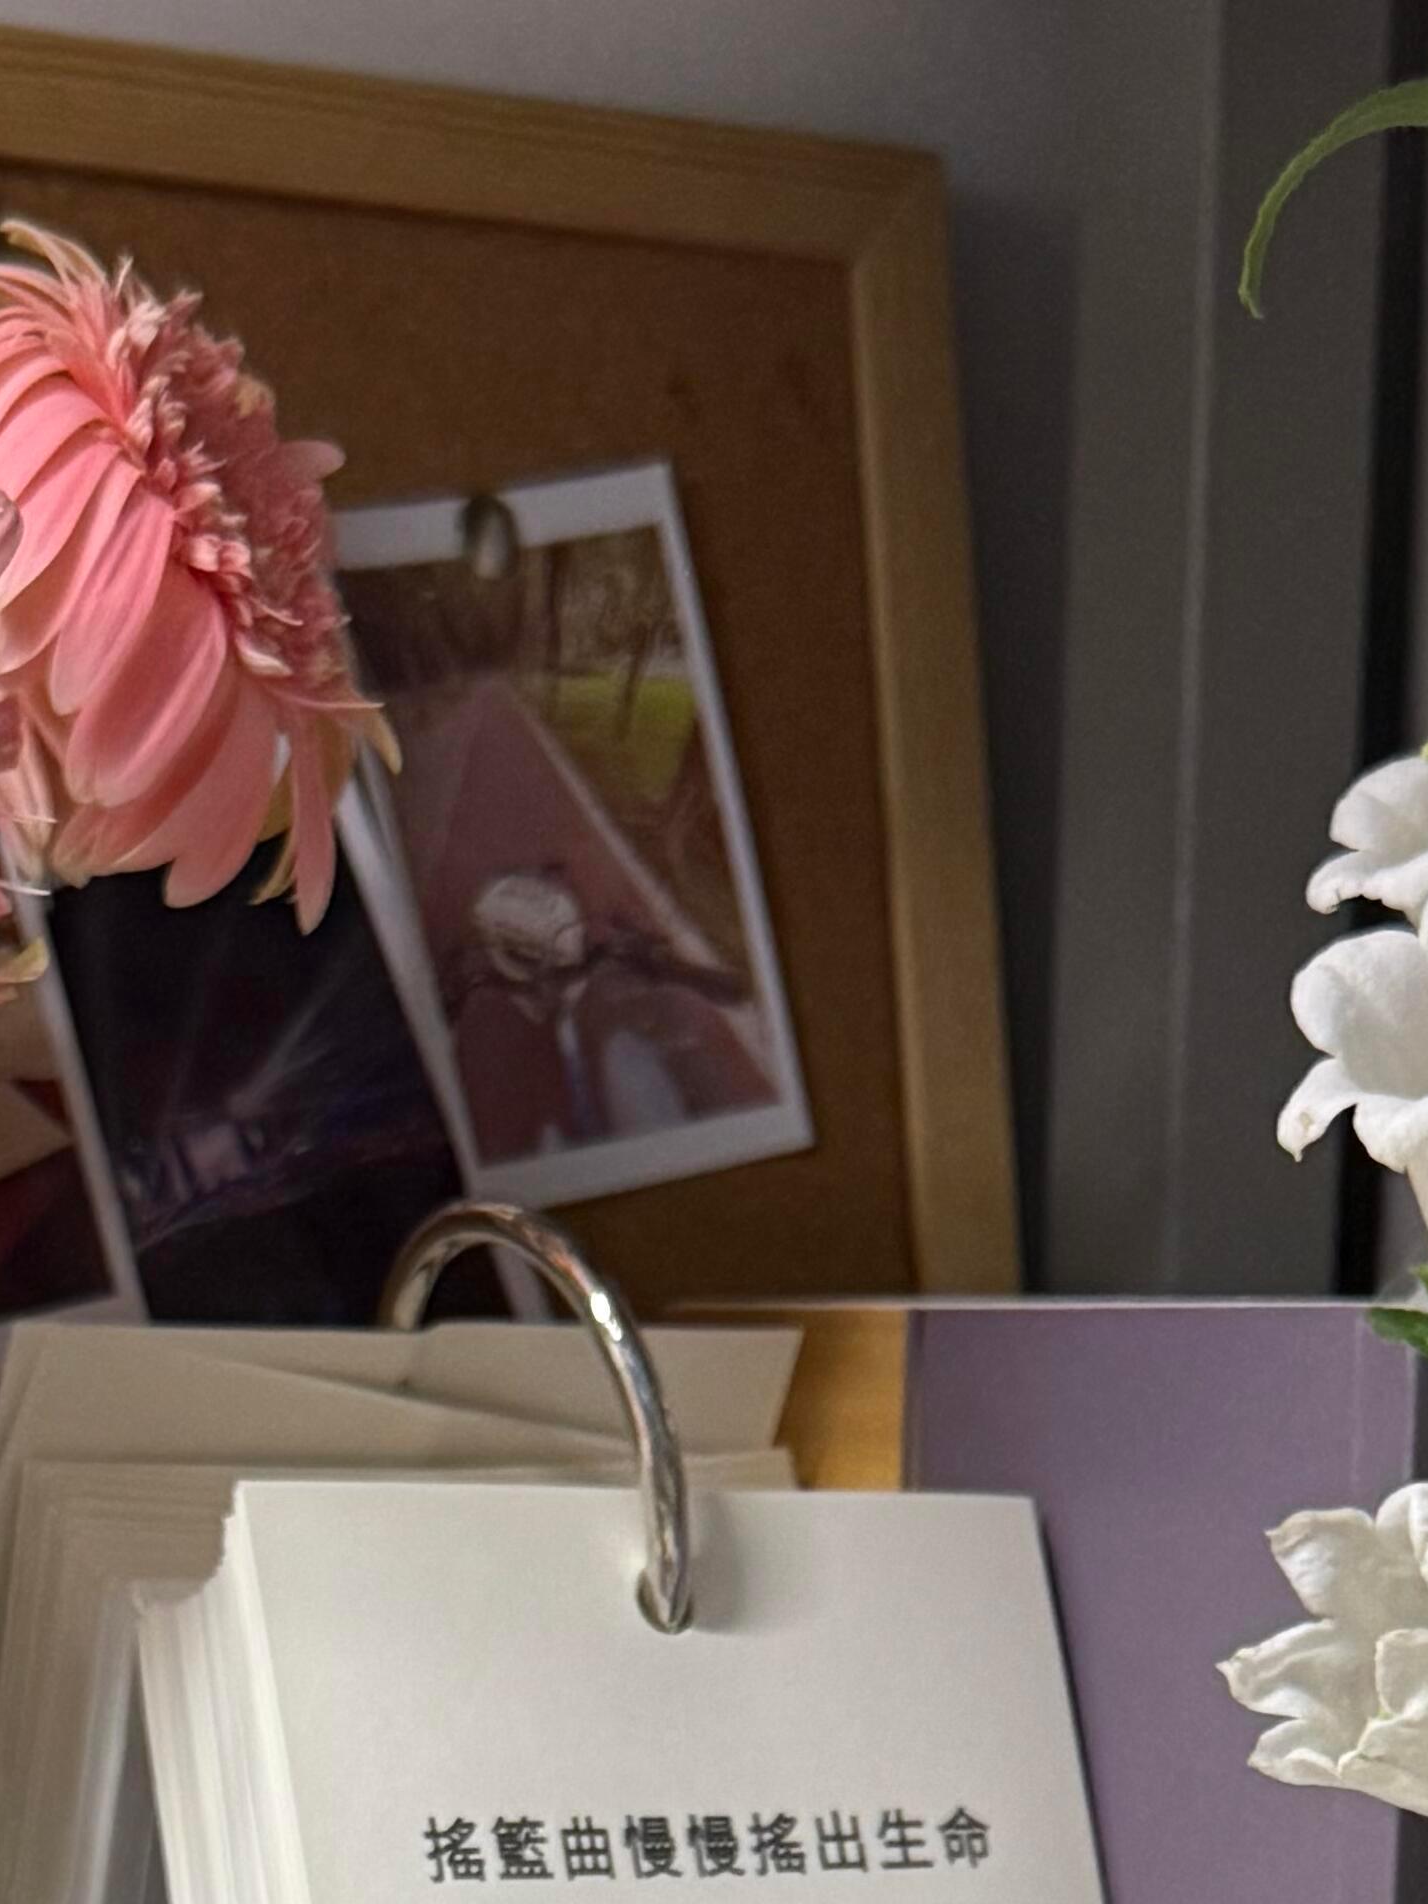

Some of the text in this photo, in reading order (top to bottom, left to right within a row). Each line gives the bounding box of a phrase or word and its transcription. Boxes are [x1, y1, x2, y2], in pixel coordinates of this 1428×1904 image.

[424, 1807, 991, 1883] 搖籃曲慢慢搖出生命
